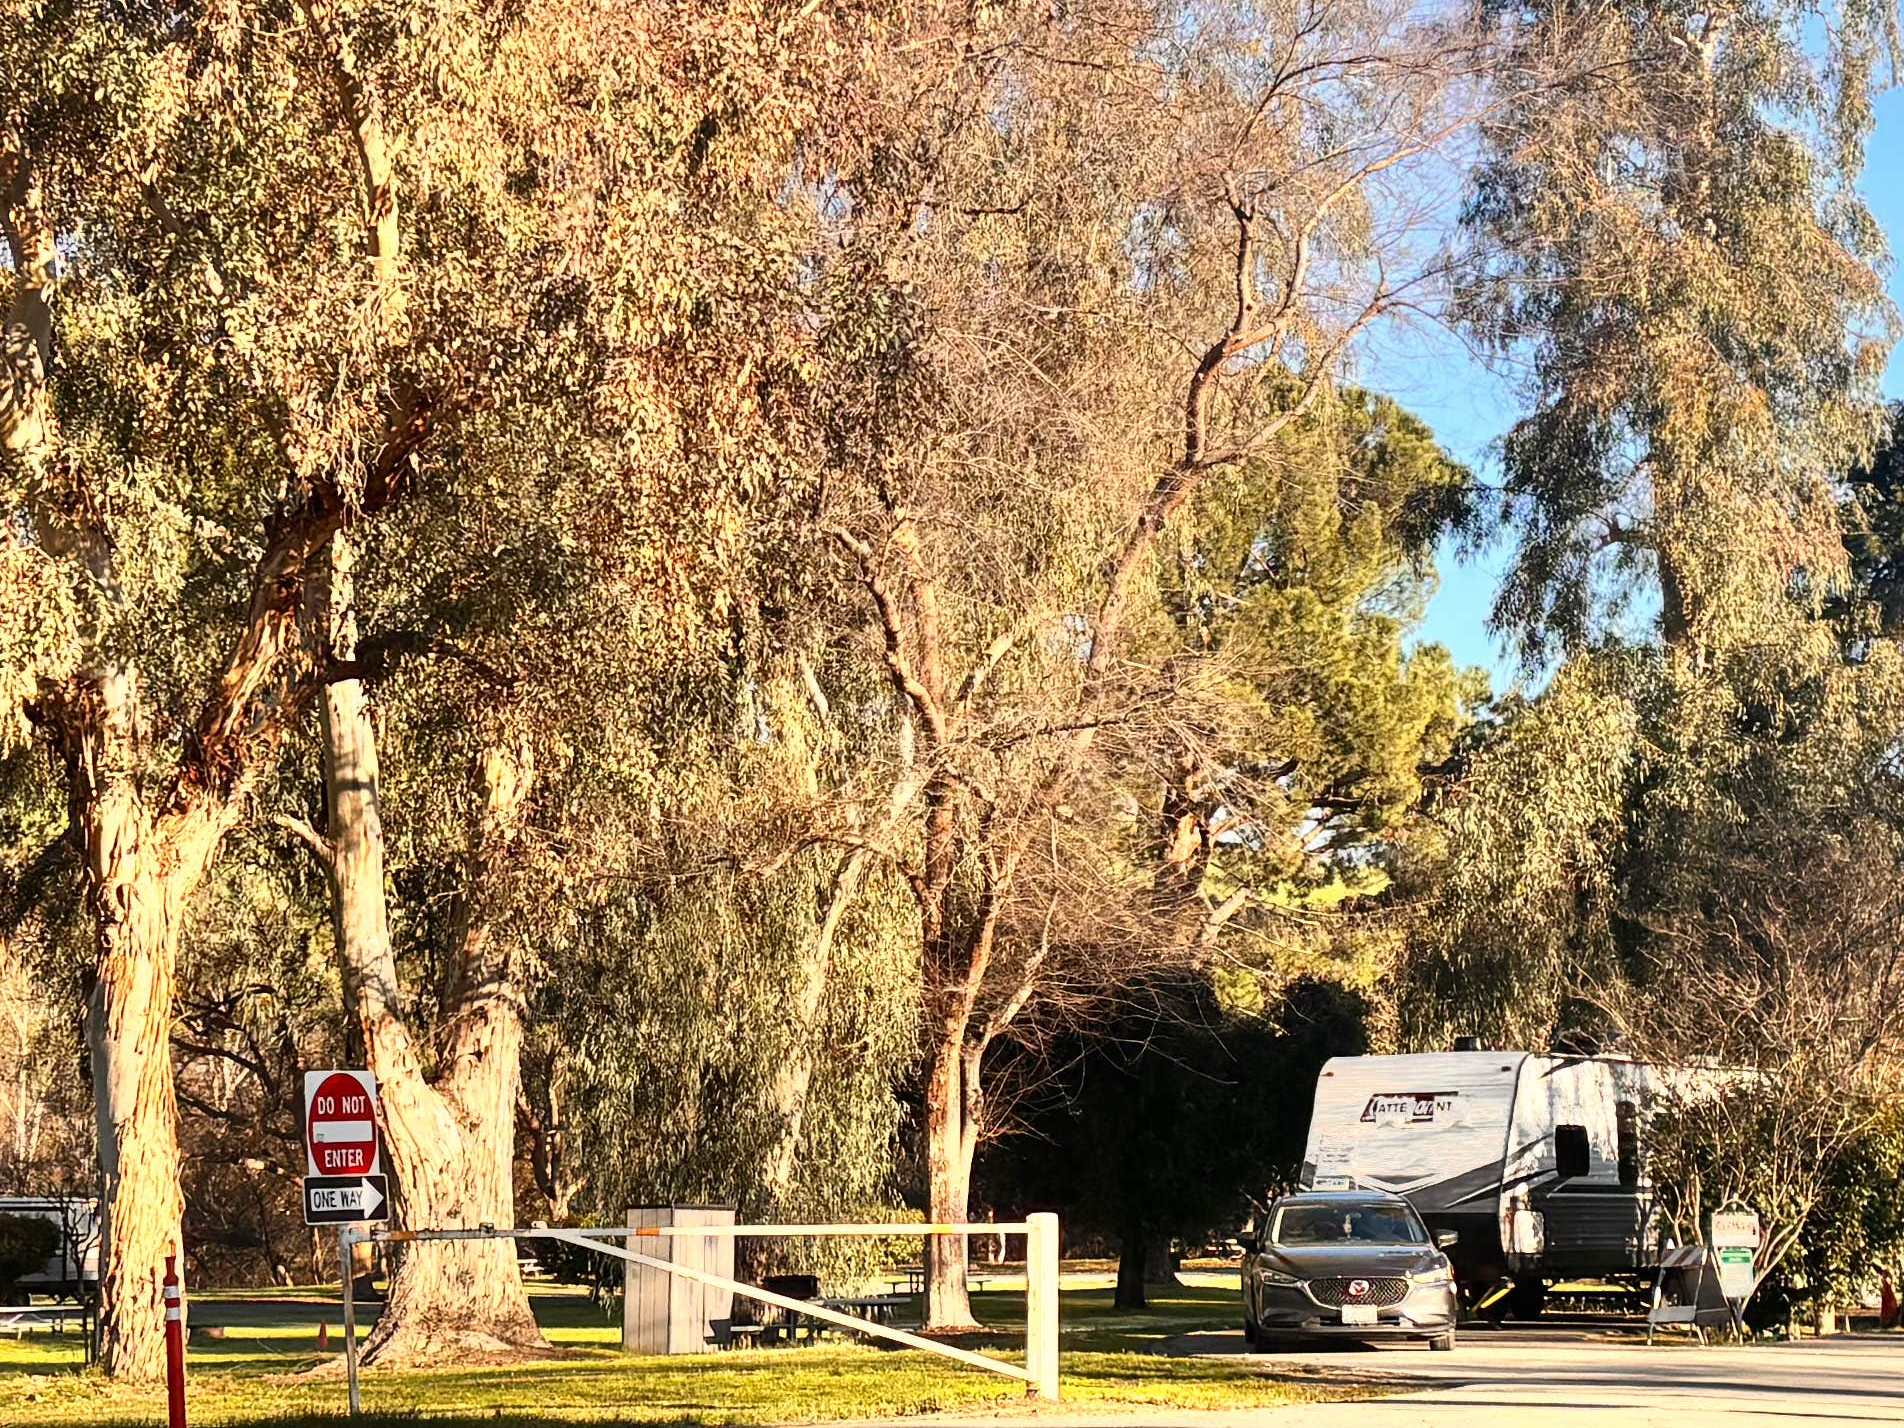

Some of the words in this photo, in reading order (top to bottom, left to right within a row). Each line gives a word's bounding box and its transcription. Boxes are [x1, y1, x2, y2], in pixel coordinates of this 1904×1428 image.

[317, 1096, 335, 1115] DO
[342, 1095, 365, 1114] NOT
[324, 1149, 364, 1168] ENTER
[313, 1190, 337, 1208] ONE
[340, 1190, 363, 1208] WAY
